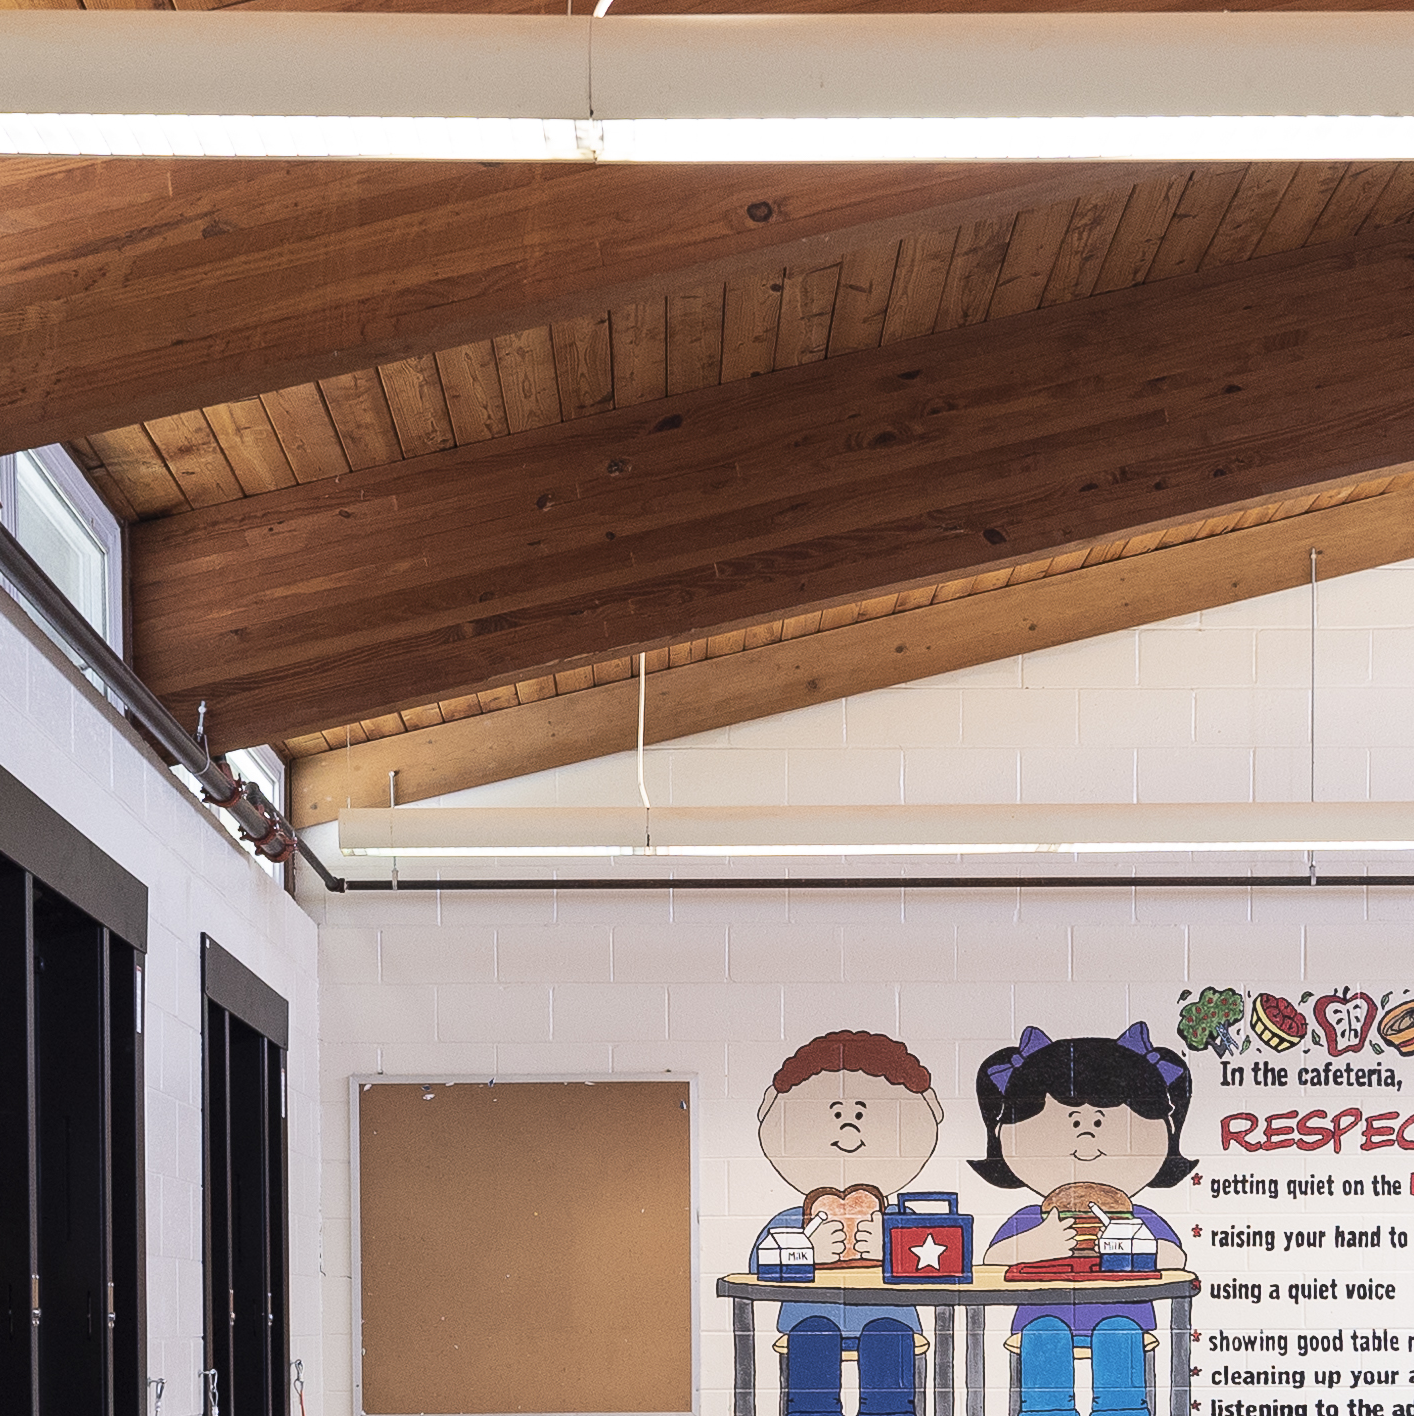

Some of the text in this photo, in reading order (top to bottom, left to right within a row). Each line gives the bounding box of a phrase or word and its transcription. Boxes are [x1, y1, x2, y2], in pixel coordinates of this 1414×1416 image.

[1220, 1061, 1403, 1092] In the cafeteria,
[1210, 1173, 1279, 1200] getting
[1287, 1173, 1335, 1200] quiet
[1343, 1179, 1365, 1196] on
[1372, 1174, 1402, 1197] the
[1211, 1224, 1275, 1252] raising
[1284, 1230, 1326, 1252] your
[1335, 1225, 1381, 1249] hand
[1389, 1226, 1408, 1249] to
[1210, 1277, 1396, 1305] using a quiet voice
[1209, 1329, 1288, 1356] showing
[1297, 1328, 1344, 1357] good
[1351, 1328, 1400, 1352] table
[1211, 1365, 1306, 1389] cleaning
[1314, 1370, 1342, 1389] up
[1349, 1370, 1400, 1389] your
